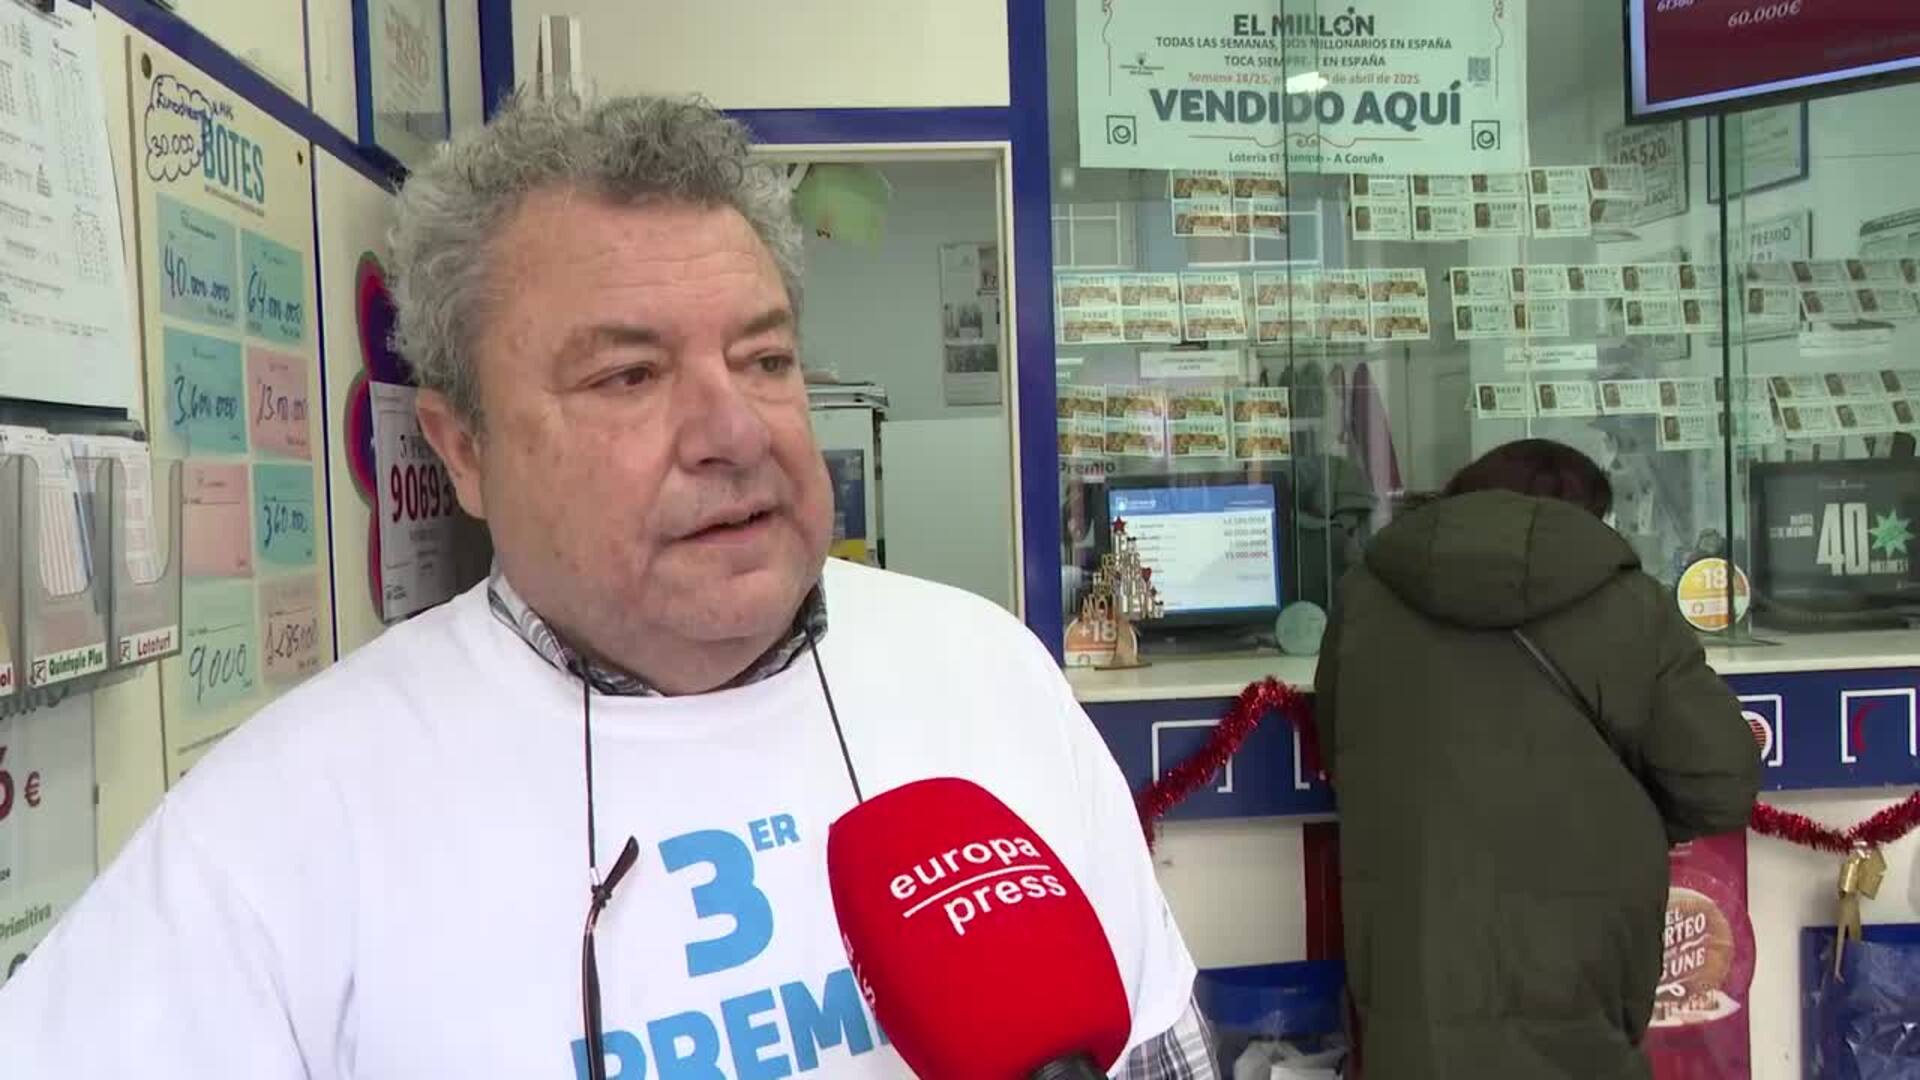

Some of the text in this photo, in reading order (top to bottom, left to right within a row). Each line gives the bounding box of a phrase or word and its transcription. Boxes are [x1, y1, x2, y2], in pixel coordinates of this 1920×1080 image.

[1233, 7, 1375, 37] EL MILLÓN
[1728, 1, 1801, 27] 60.000€
[1156, 37, 1194, 48] TODAS
[1198, 37, 1217, 48] LAS
[1220, 38, 1279, 51] SEMANAS,
[1310, 39, 1388, 50] MILLONARIOS
[1390, 38, 1406, 49] EN
[1408, 37, 1452, 49] ESPAÑA
[1224, 56, 1254, 67] TOCA
[1323, 56, 1338, 67] EN
[1341, 55, 1386, 67] ESPAÑA
[1188, 72, 1232, 83] Semana
[1393, 73, 1419, 84] 2025
[1150, 79, 1461, 131] VENDIDO AQUÍ
[202, 114, 265, 204] BOTES
[1345, 152, 1384, 164] Coruña
[1816, 503, 1869, 576] 40
[1079, 621, 1117, 642] +18
[0, 667, 11, 687] ol
[24, 771, 41, 807] €
[890, 836, 1041, 899] europa
[658, 813, 800, 978] 3 ER
[943, 873, 1067, 936] press
[1663, 912, 1706, 948] RTEO
[1671, 946, 1706, 977] UNE
